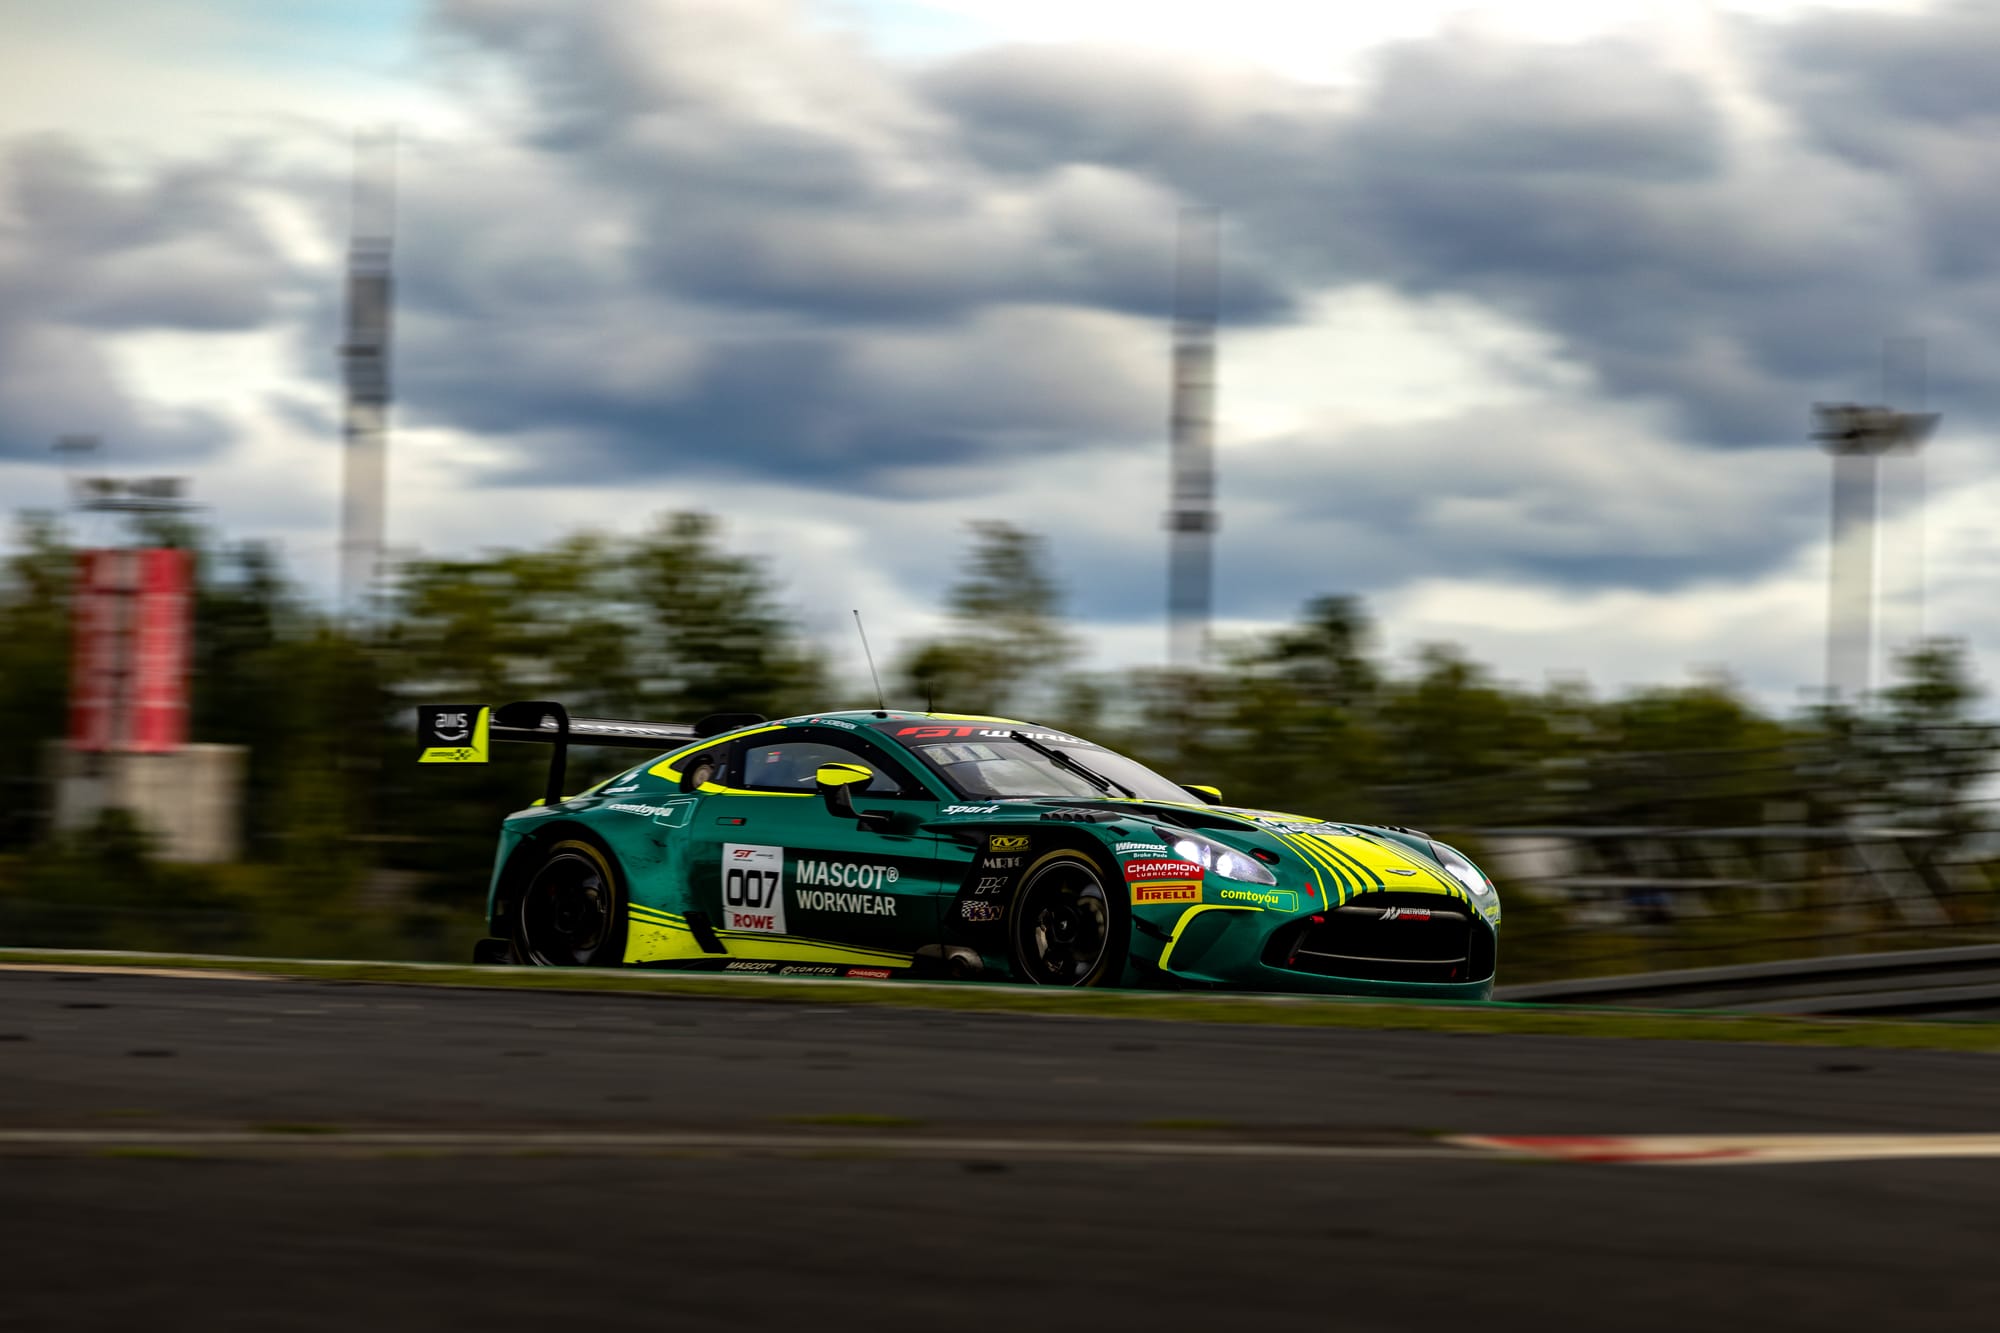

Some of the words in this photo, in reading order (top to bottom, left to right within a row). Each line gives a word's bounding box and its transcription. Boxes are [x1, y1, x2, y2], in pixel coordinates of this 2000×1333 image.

[434, 713, 468, 728] aws
[1115, 842, 1168, 852] Winmax
[1127, 863, 1200, 874] CHAMPION
[727, 868, 780, 909] 007
[1136, 885, 1196, 901] PIRELLI
[1220, 888, 1279, 904] comtoyou
[796, 889, 897, 916] WORKWEAR
[733, 913, 776, 930] ROWE
